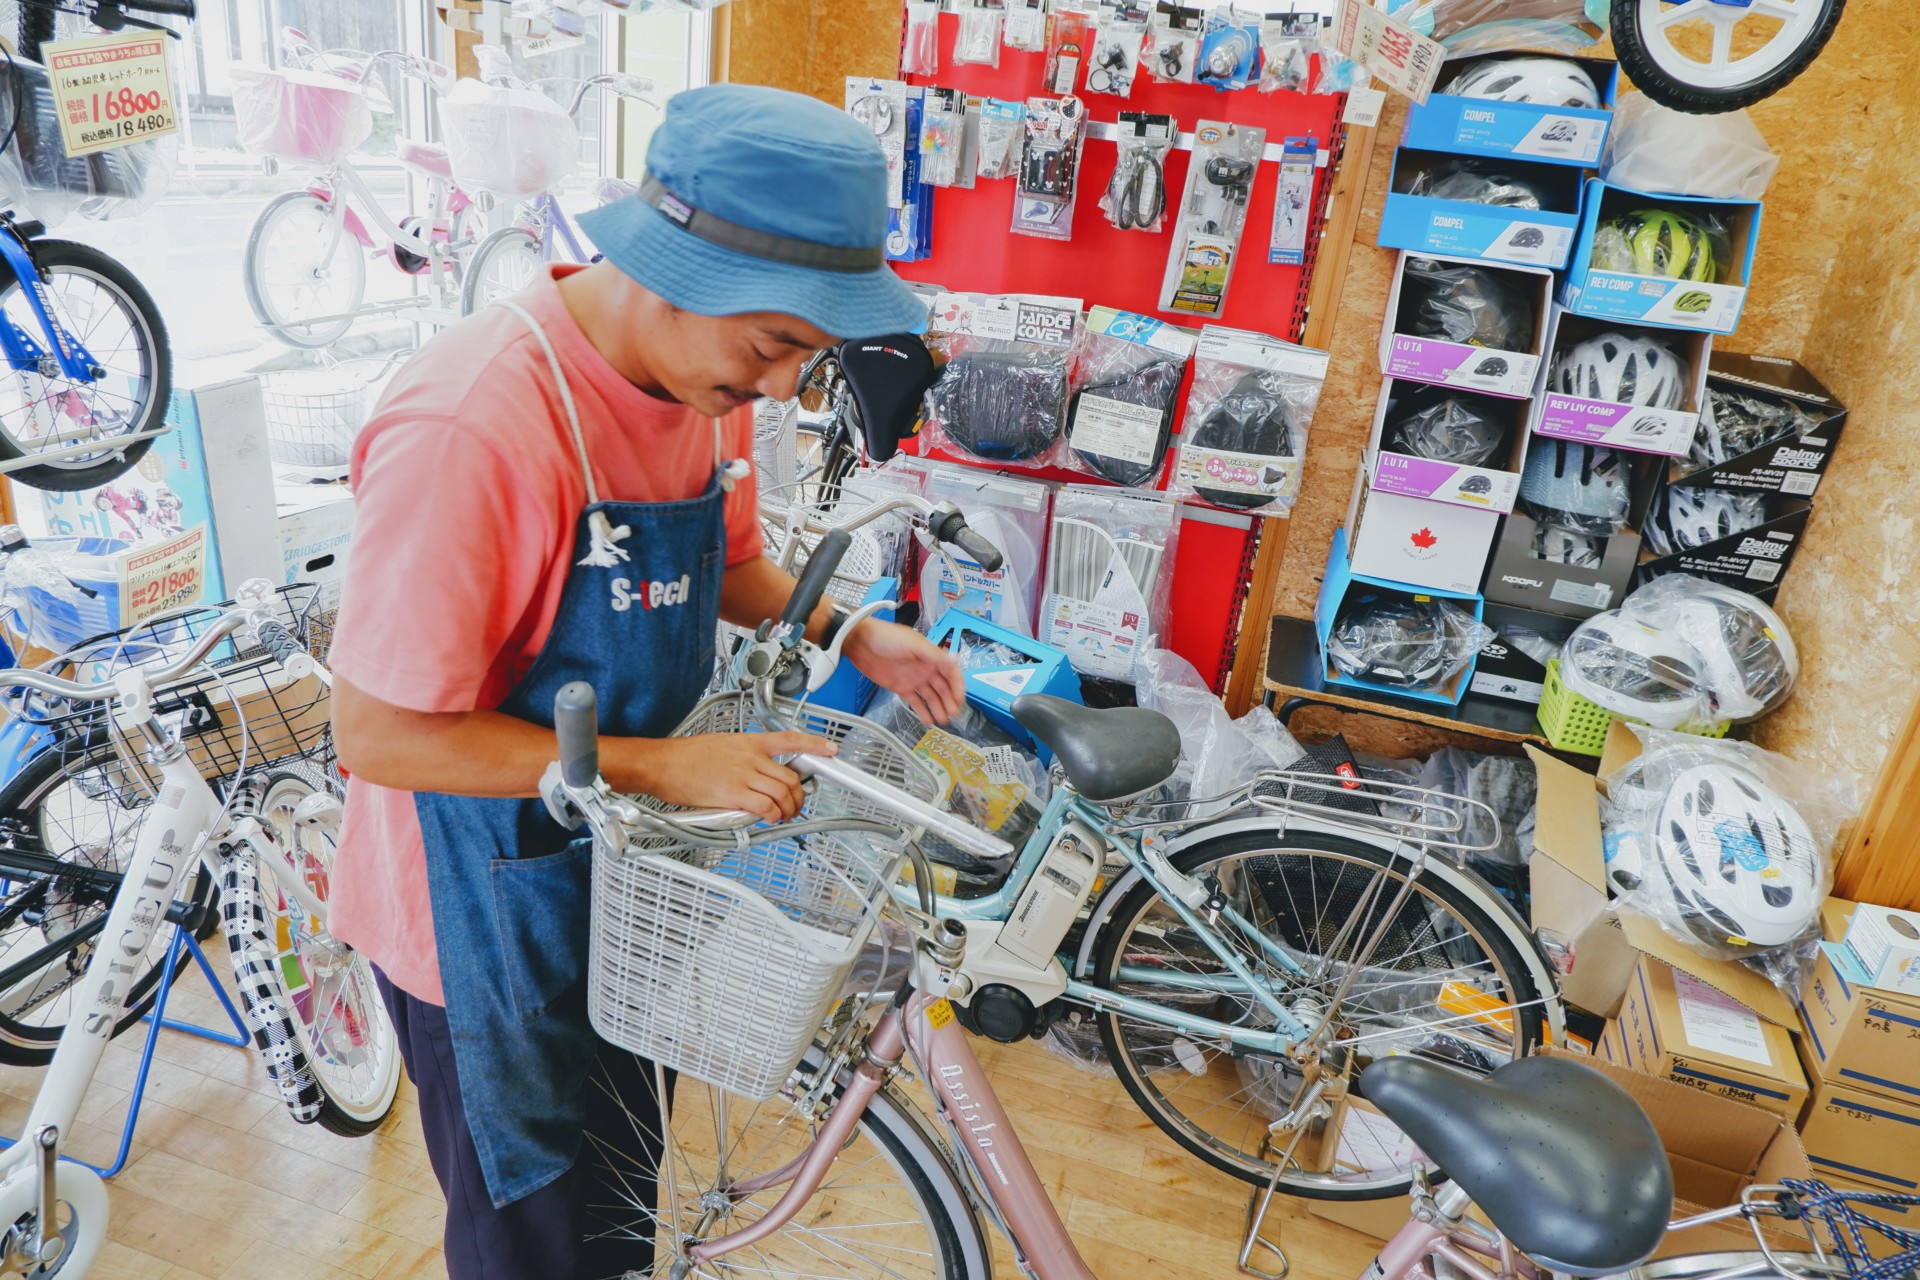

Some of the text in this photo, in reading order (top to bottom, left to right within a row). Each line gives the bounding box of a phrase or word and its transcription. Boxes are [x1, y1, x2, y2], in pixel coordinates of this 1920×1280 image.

[1463, 109, 1496, 124] COMPEL
[1433, 216, 1464, 230] COMPEL
[1590, 277, 1634, 291] REV COMP
[1019, 311, 1072, 329] HANDLE
[1017, 326, 1064, 343] COVER
[1397, 340, 1423, 353] LUTA
[1550, 400, 1616, 417] REV LIV COMP
[1384, 457, 1408, 469] LUTA
[1207, 458, 1258, 484] ふかふか
[1728, 472, 1756, 482] Bicycle
[1755, 476, 1782, 484] Helmet
[1418, 553, 1439, 561] CANADA
[1694, 558, 1721, 567] Bicycle
[1720, 562, 1747, 571] Helmet
[1501, 574, 1544, 588] KOOFU
[1124, 614, 1137, 622] UV
[1019, 890, 1039, 923] BRIDGESTONE
